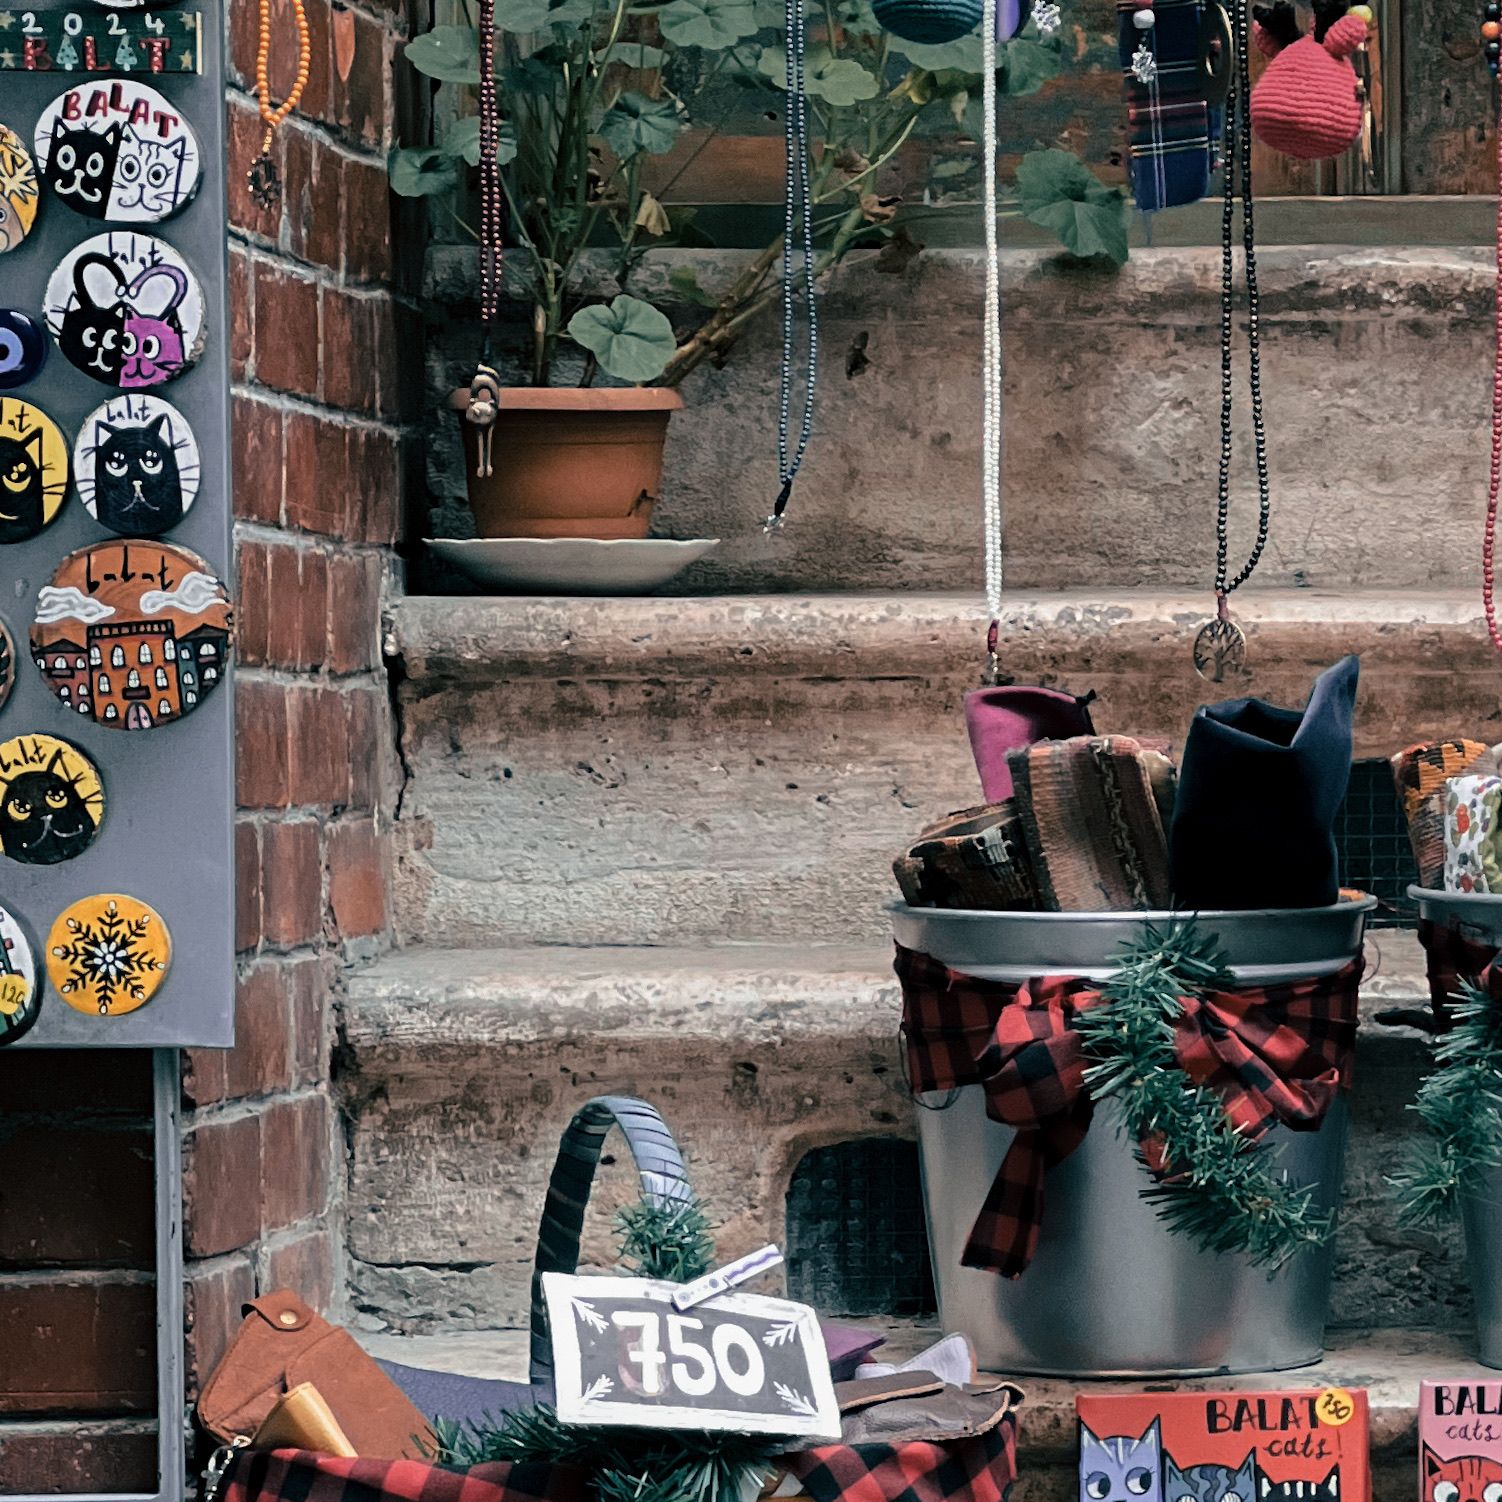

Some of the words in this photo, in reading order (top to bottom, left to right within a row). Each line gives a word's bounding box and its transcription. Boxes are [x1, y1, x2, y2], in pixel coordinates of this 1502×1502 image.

[21, 11, 165, 36] 2024
[61, 82, 179, 138] BALAT
[612, 1310, 765, 1397] 750
[1206, 1396, 1320, 1434] BALAT
